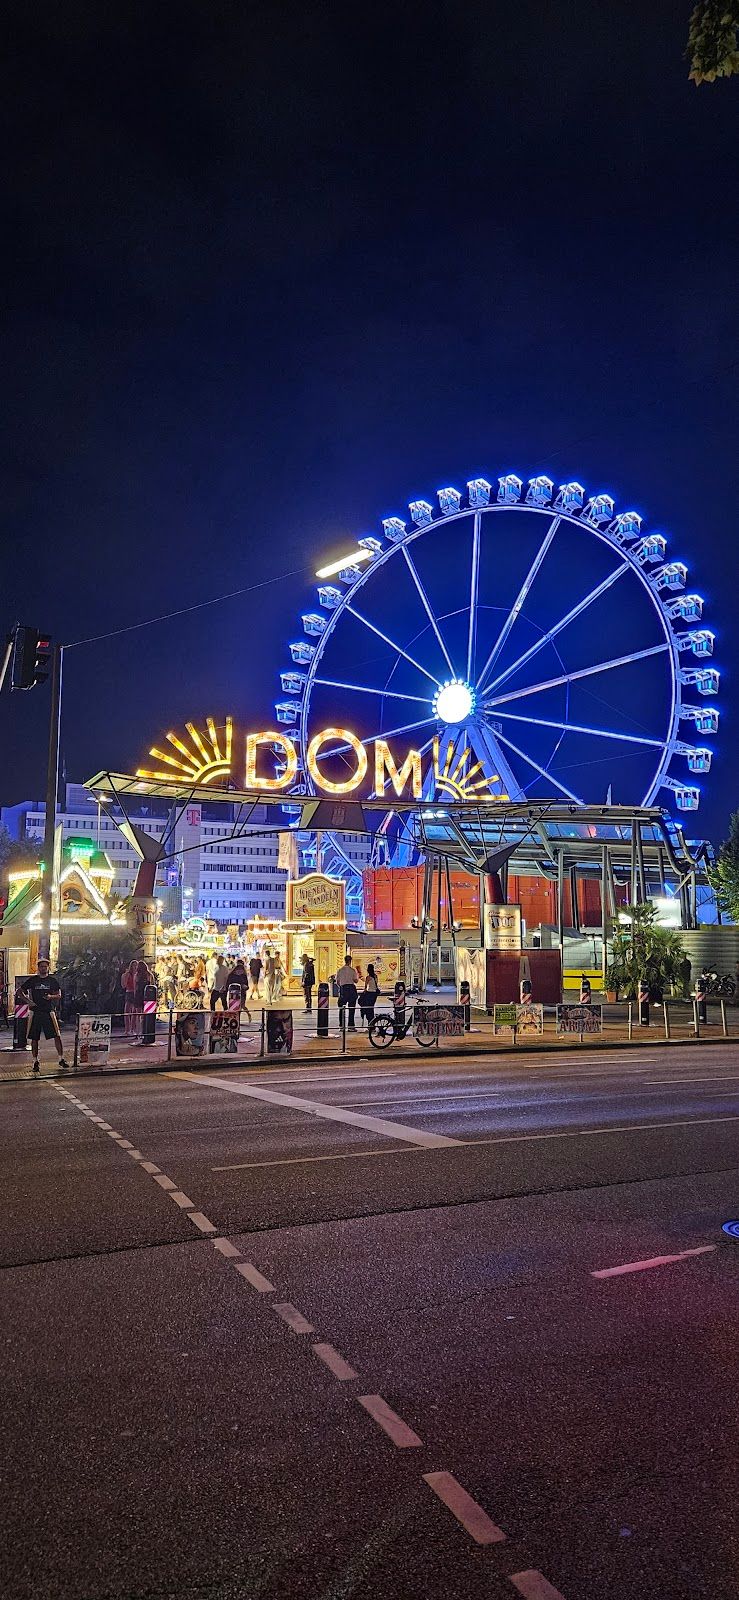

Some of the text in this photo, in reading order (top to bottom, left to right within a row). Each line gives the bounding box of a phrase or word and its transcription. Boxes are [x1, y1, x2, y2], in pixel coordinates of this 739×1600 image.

[246, 727, 423, 799] DOM
[186, 809, 201, 827] T
[299, 884, 327, 900] WIENER
[307, 888, 338, 905] MANDELN
[415, 1021, 462, 1036] ARENA
[560, 1018, 602, 1033] ARENA
